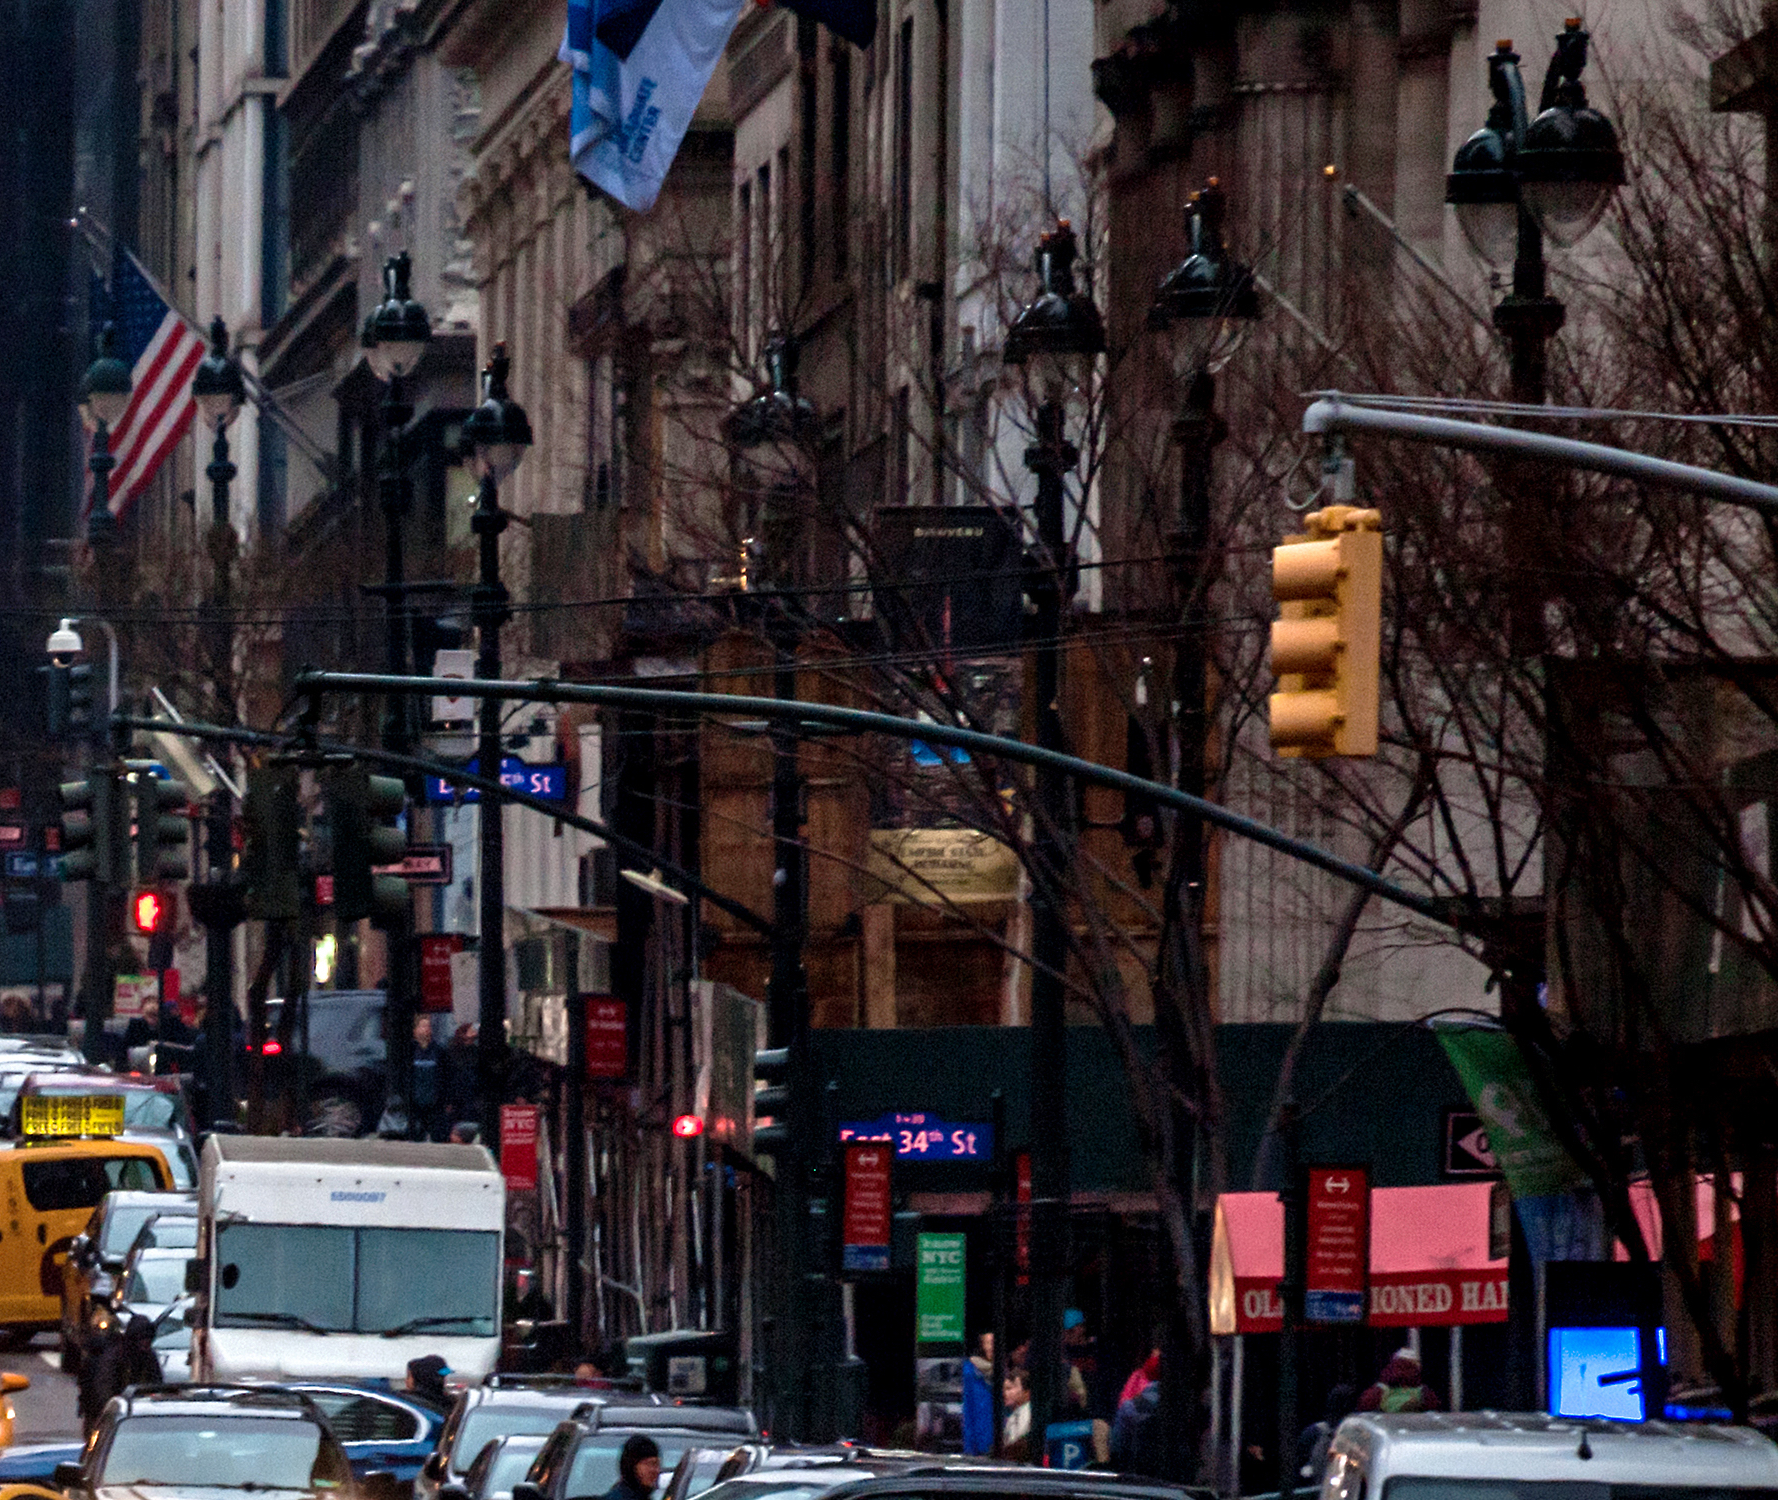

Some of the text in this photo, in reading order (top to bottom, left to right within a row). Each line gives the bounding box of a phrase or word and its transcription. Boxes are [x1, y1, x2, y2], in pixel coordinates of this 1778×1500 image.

[531, 773, 551, 793] St
[898, 1128, 944, 1154] 34th
[951, 1129, 977, 1155] St
[922, 1251, 962, 1264] NYC
[1244, 1289, 1283, 1318] OL
[1371, 1283, 1453, 1314] IONED
[1064, 1443, 1081, 1469] P
